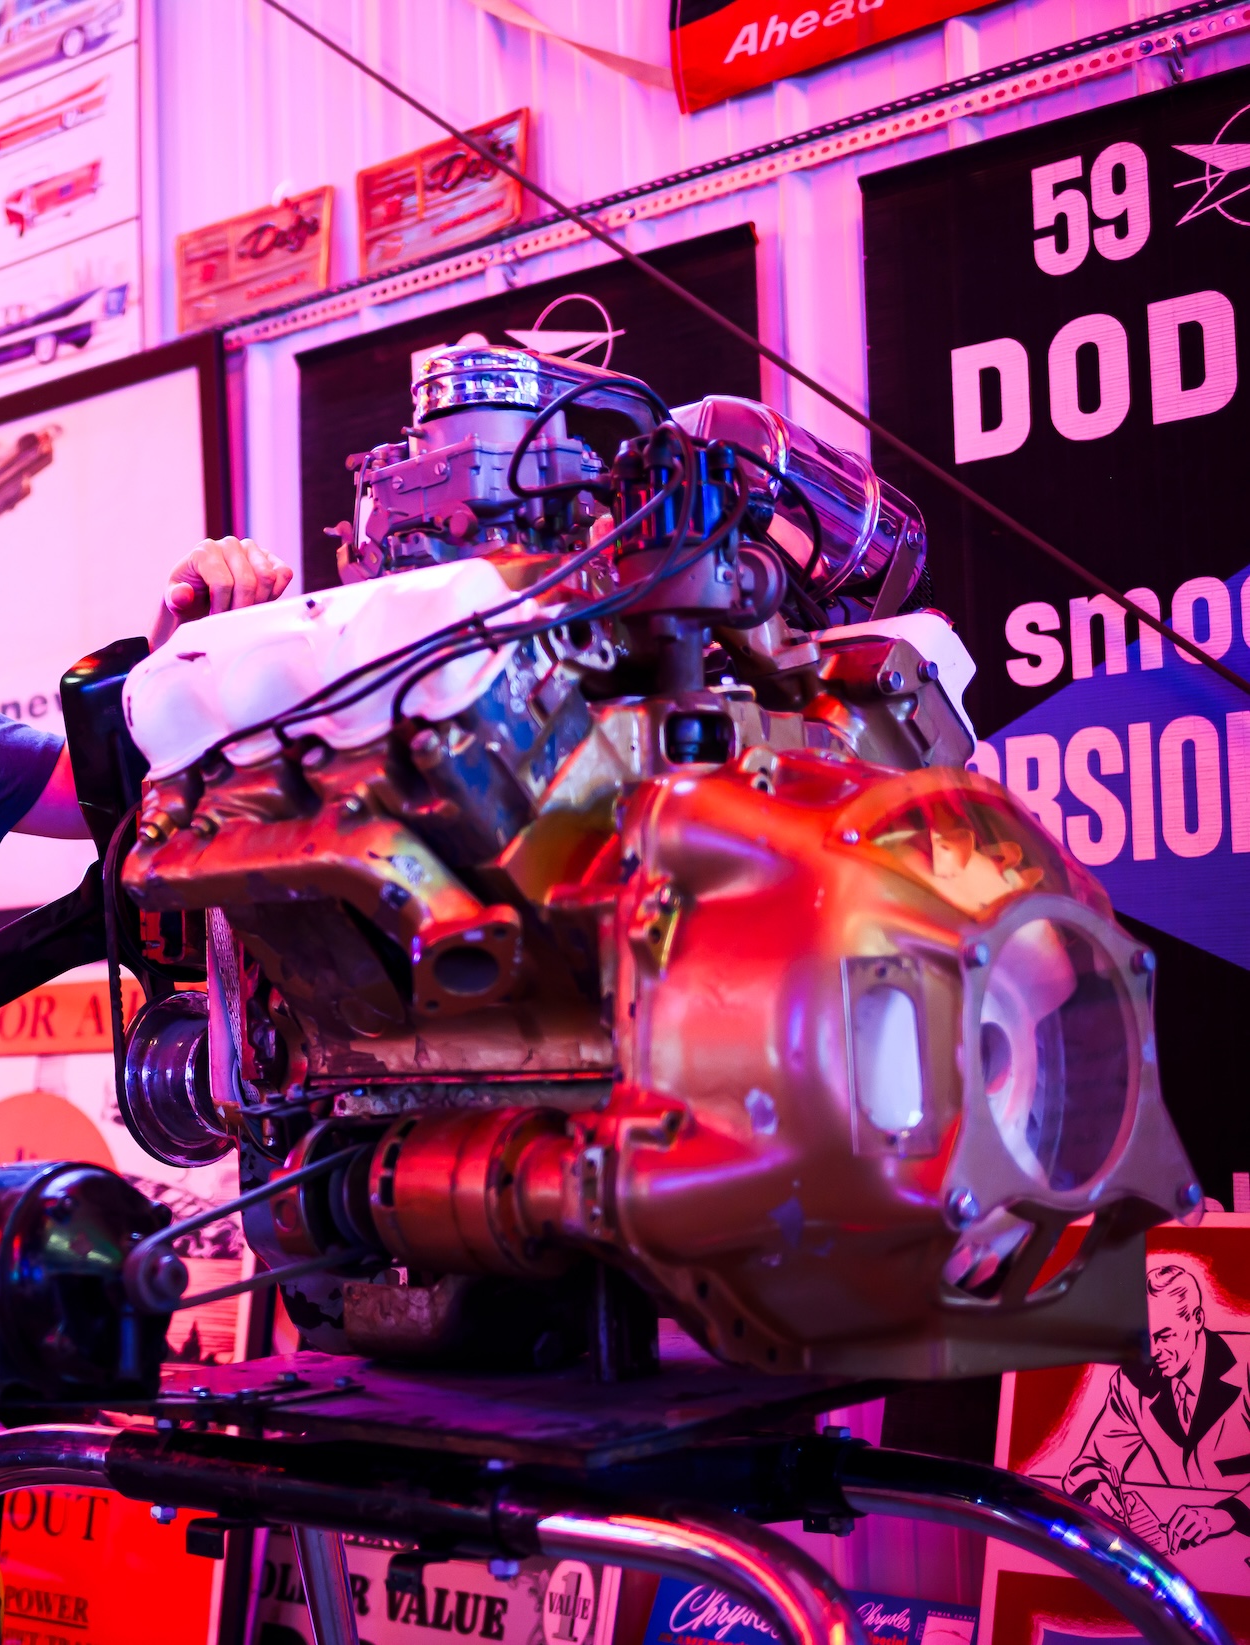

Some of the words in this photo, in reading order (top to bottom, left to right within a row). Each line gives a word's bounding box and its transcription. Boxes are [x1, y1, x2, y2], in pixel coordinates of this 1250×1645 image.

[1031, 141, 1150, 276] 59
[1004, 576, 1250, 688] smo
[8, 1488, 109, 1541] OUT
[4, 1585, 88, 1623] POWER
[386, 1582, 509, 1641] VALUE
[550, 1592, 591, 1620] VALUE
[856, 1601, 911, 1633] Chrysler
